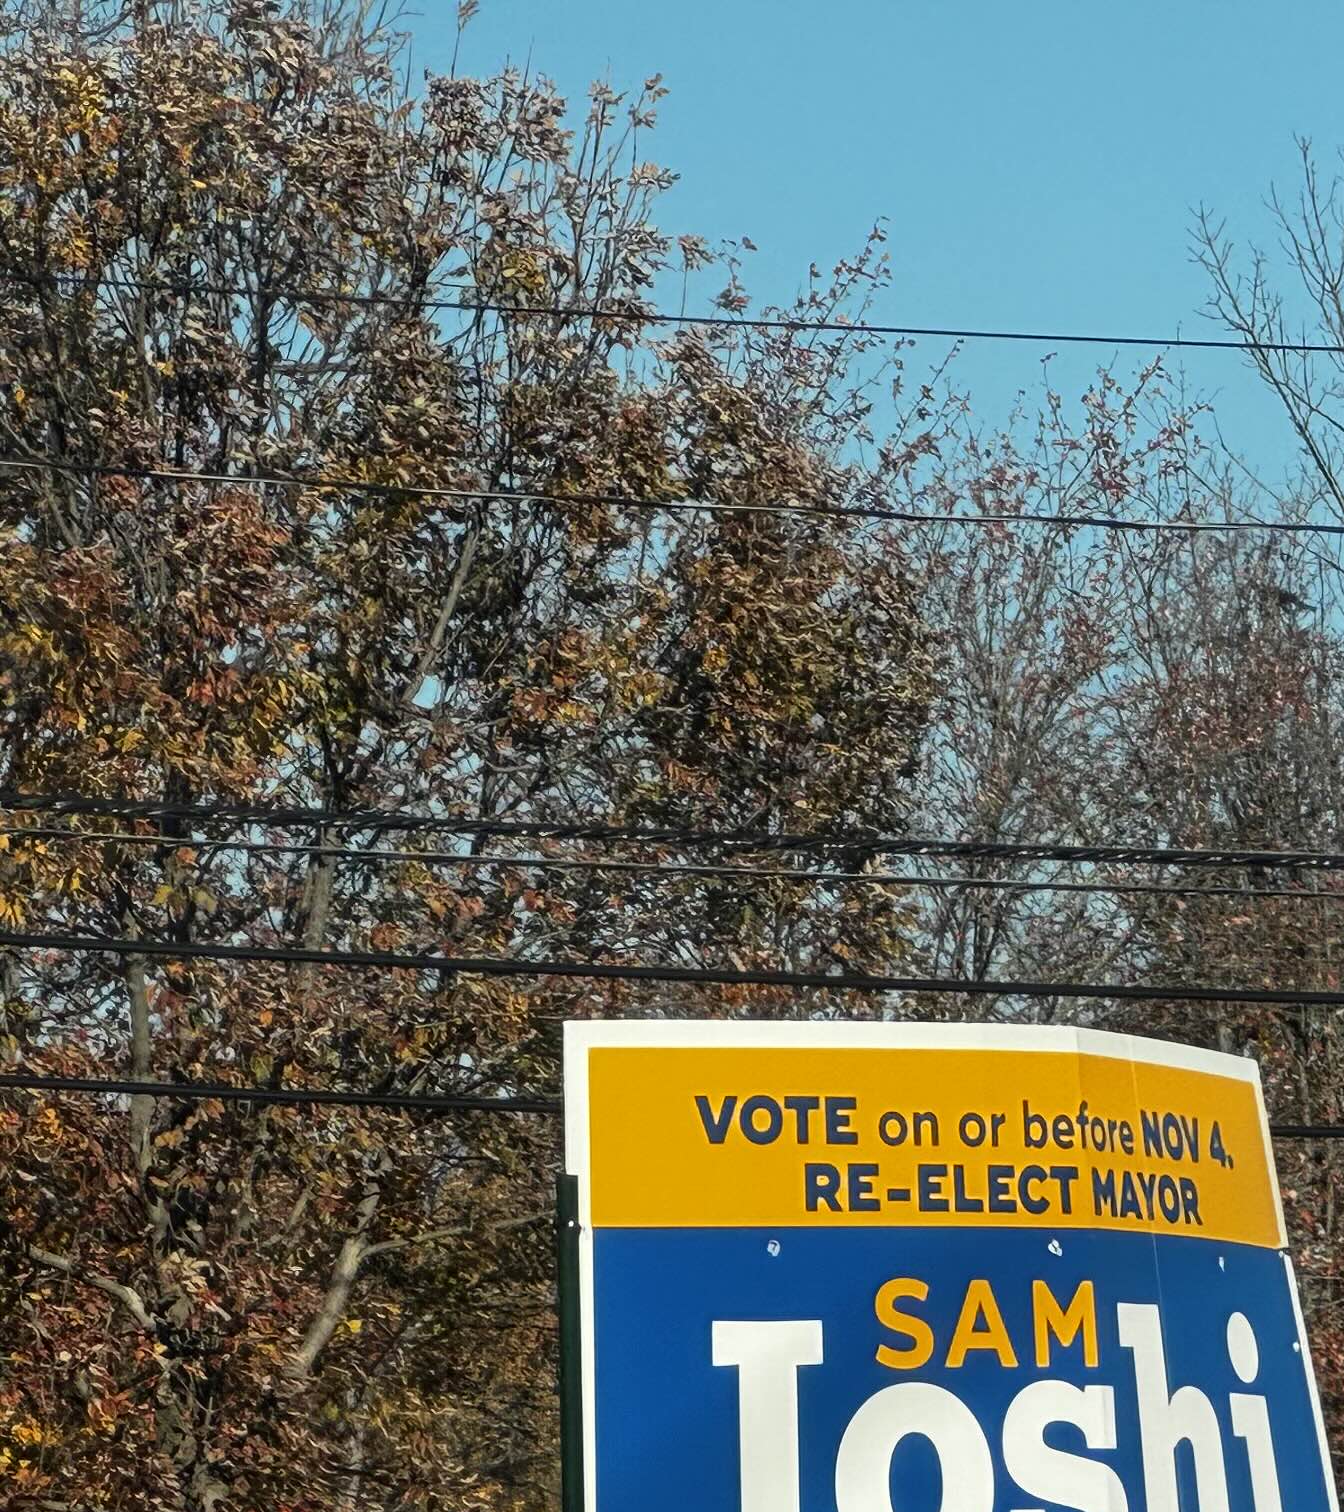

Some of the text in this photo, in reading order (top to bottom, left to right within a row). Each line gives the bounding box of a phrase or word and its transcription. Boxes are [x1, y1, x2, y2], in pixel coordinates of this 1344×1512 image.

[694, 1094, 859, 1147] VOTE
[877, 1109, 939, 1149] on
[957, 1111, 1007, 1150] or
[1022, 1100, 1135, 1156] before
[1140, 1109, 1200, 1163] NOV
[803, 1162, 1204, 1226] RE-ELECT MAYOR
[874, 1277, 1100, 1371] SAM
